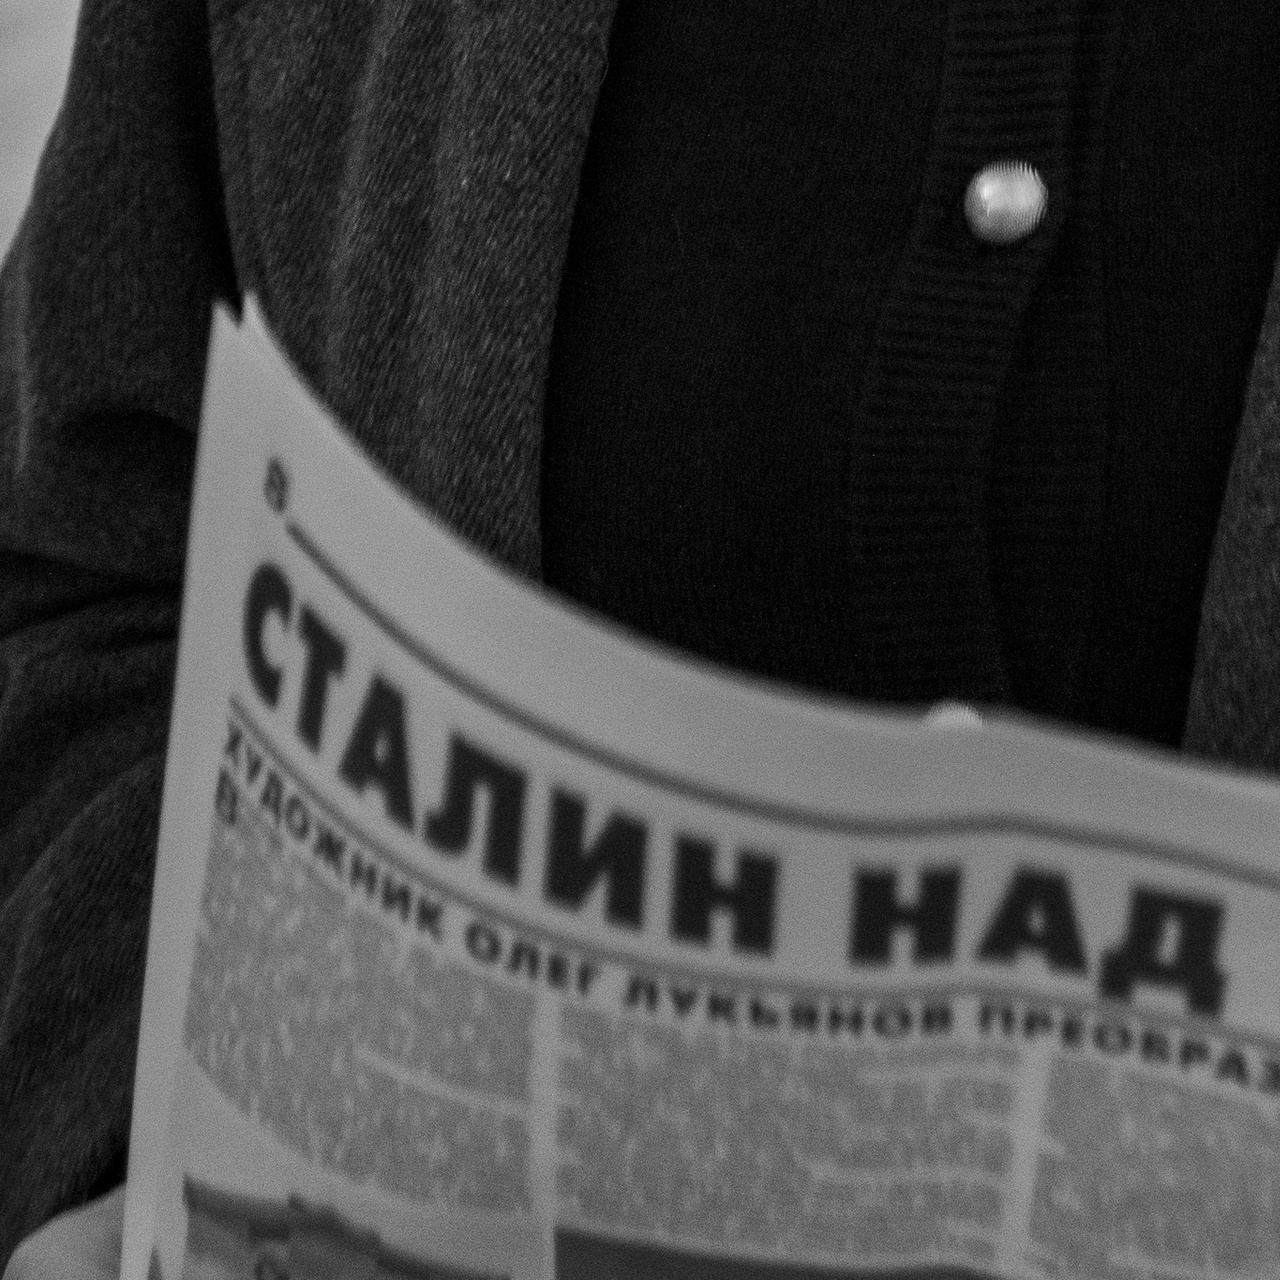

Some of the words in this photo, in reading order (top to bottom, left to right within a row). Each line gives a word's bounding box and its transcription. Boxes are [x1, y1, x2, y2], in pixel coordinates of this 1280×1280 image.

[221, 715, 446, 942] ХУДОЖНИК
[463, 920, 602, 998] ОЛЕГ
[622, 977, 955, 1038] ЛУКЬЯНОВ
[242, 560, 780, 960] СТАЛИН
[848, 860, 1228, 1018] НАД
